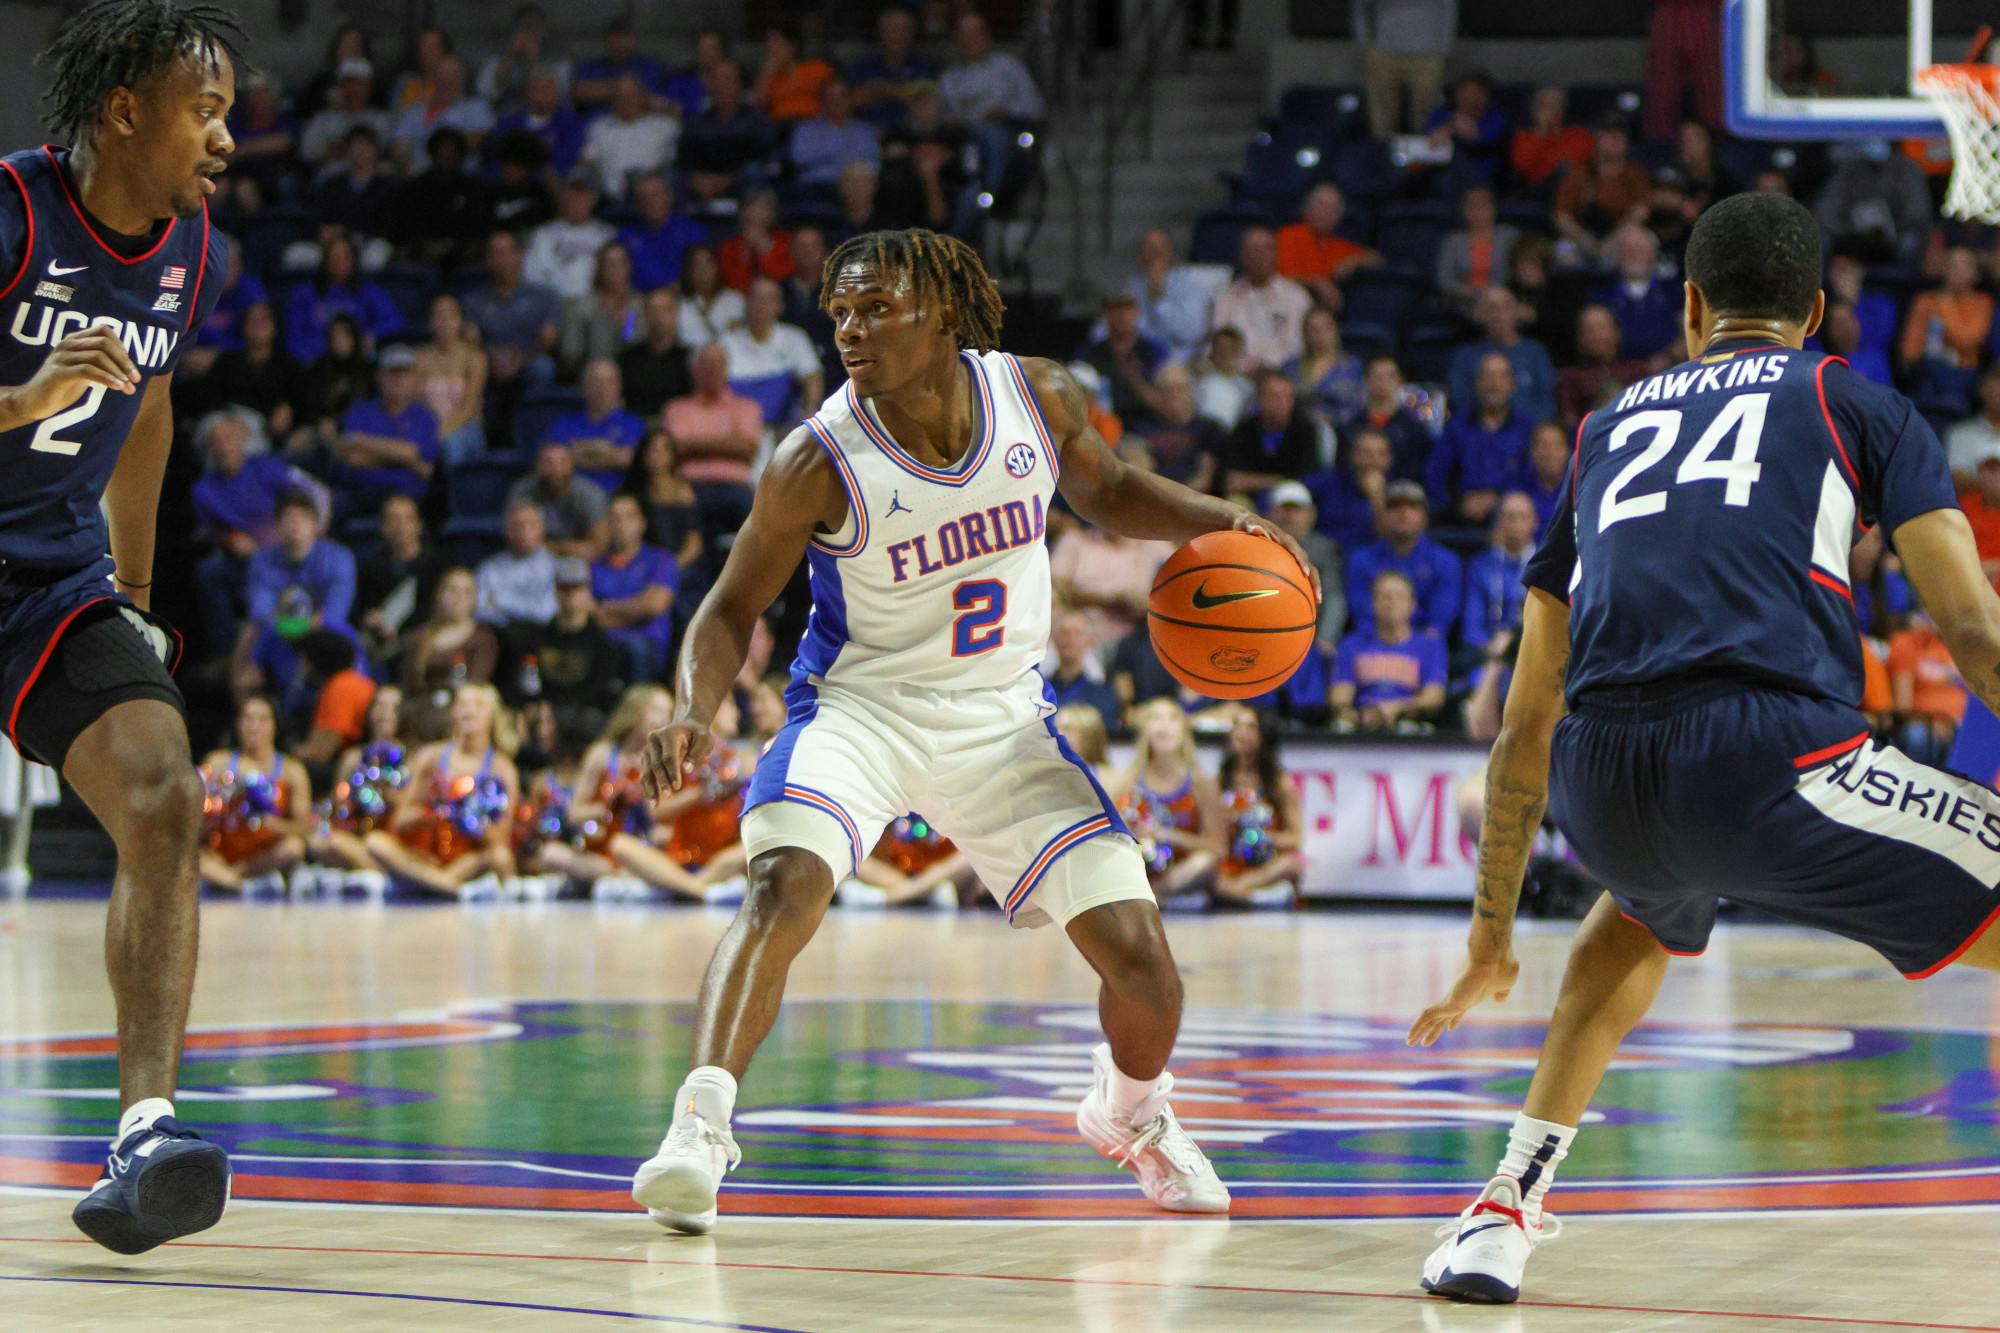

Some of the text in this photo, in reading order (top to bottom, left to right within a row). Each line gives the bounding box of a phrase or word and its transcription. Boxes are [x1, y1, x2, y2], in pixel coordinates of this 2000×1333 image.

[153, 300, 182, 310] EAST
[30, 379, 107, 456] 2
[1615, 355, 1789, 412] HAWKINS
[1007, 444, 1034, 477] SEC
[1598, 392, 1771, 534] 24
[886, 494, 1046, 583] FLORIDA
[951, 578, 1008, 657] 2
